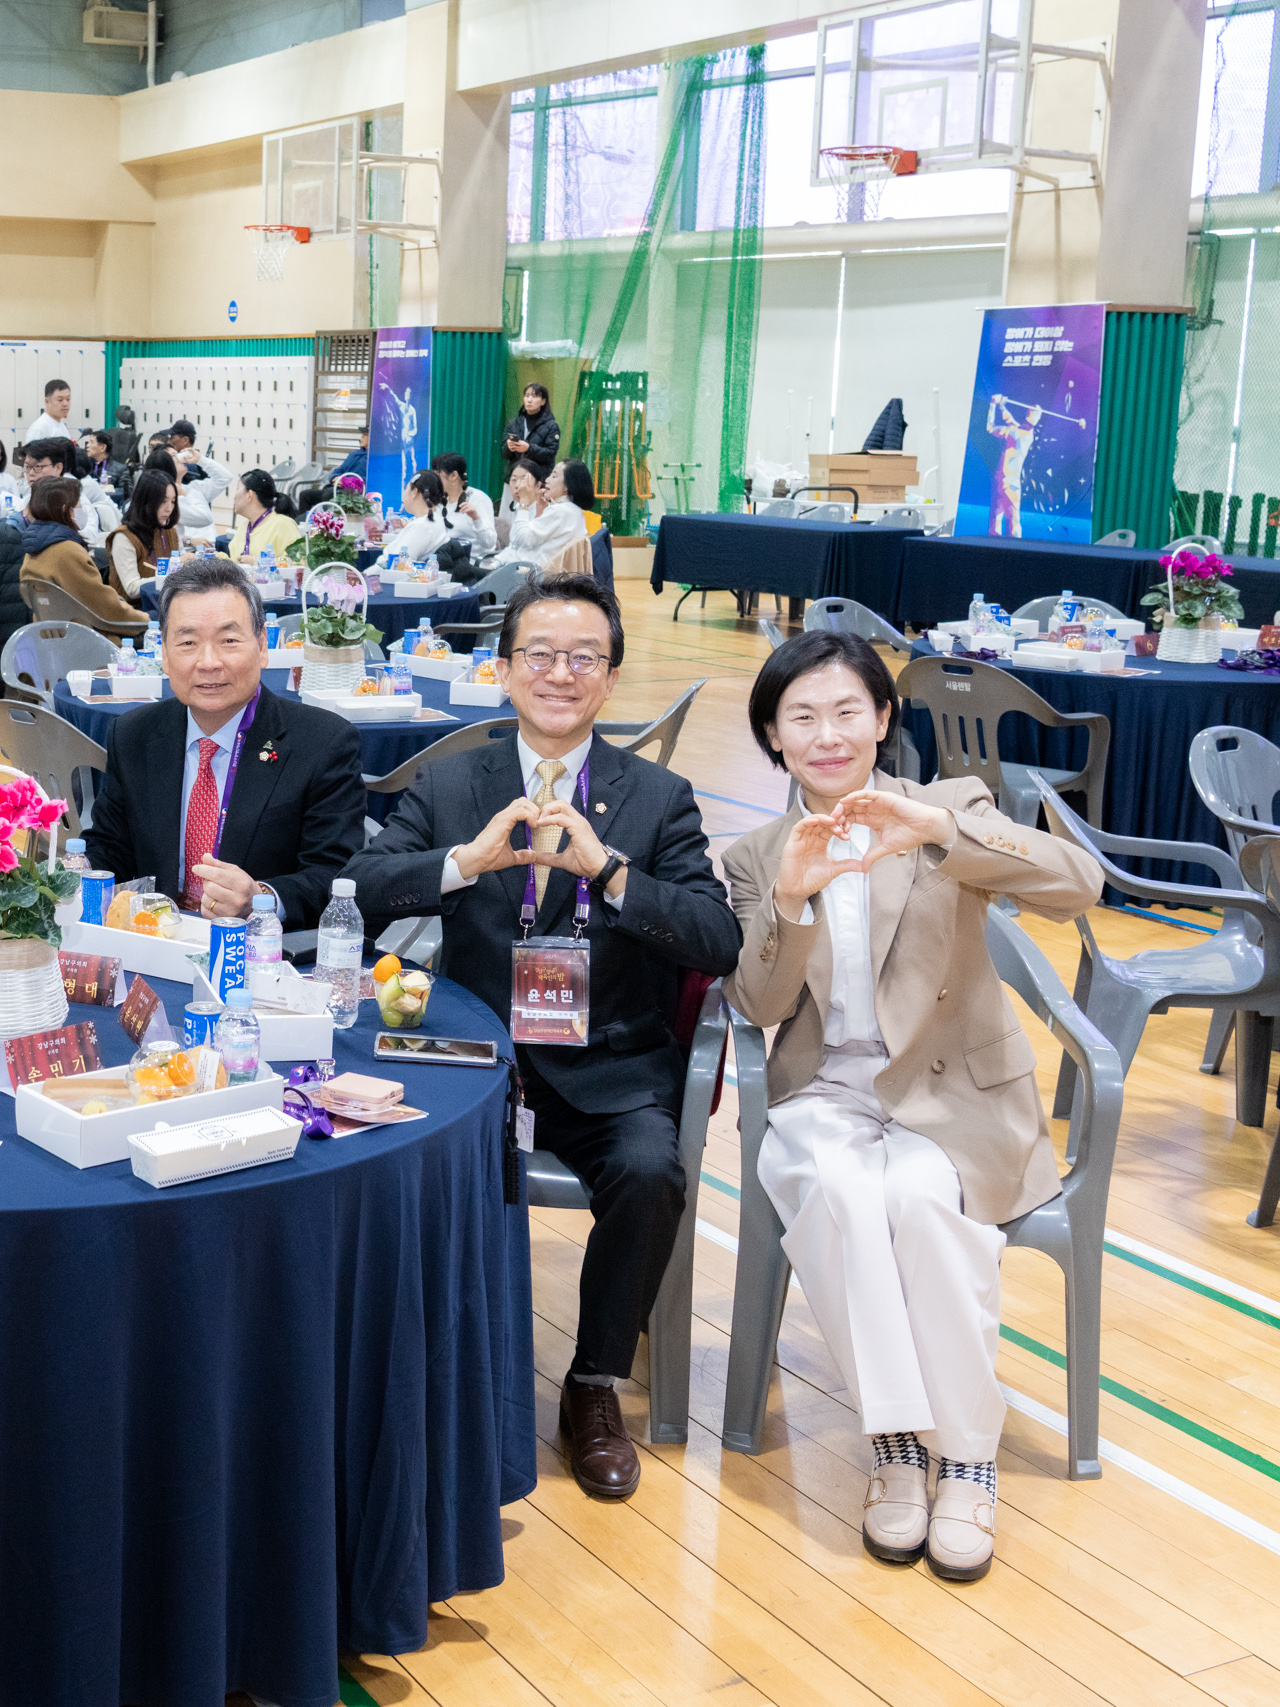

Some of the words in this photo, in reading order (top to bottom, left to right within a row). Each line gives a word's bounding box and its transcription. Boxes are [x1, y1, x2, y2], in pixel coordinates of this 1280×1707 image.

[1001, 355, 1032, 367] 스포츠
[527, 988, 573, 1003] 윤석민
[37, 1036, 67, 1051] 강남구의회
[28, 1054, 87, 1083] 손민기
